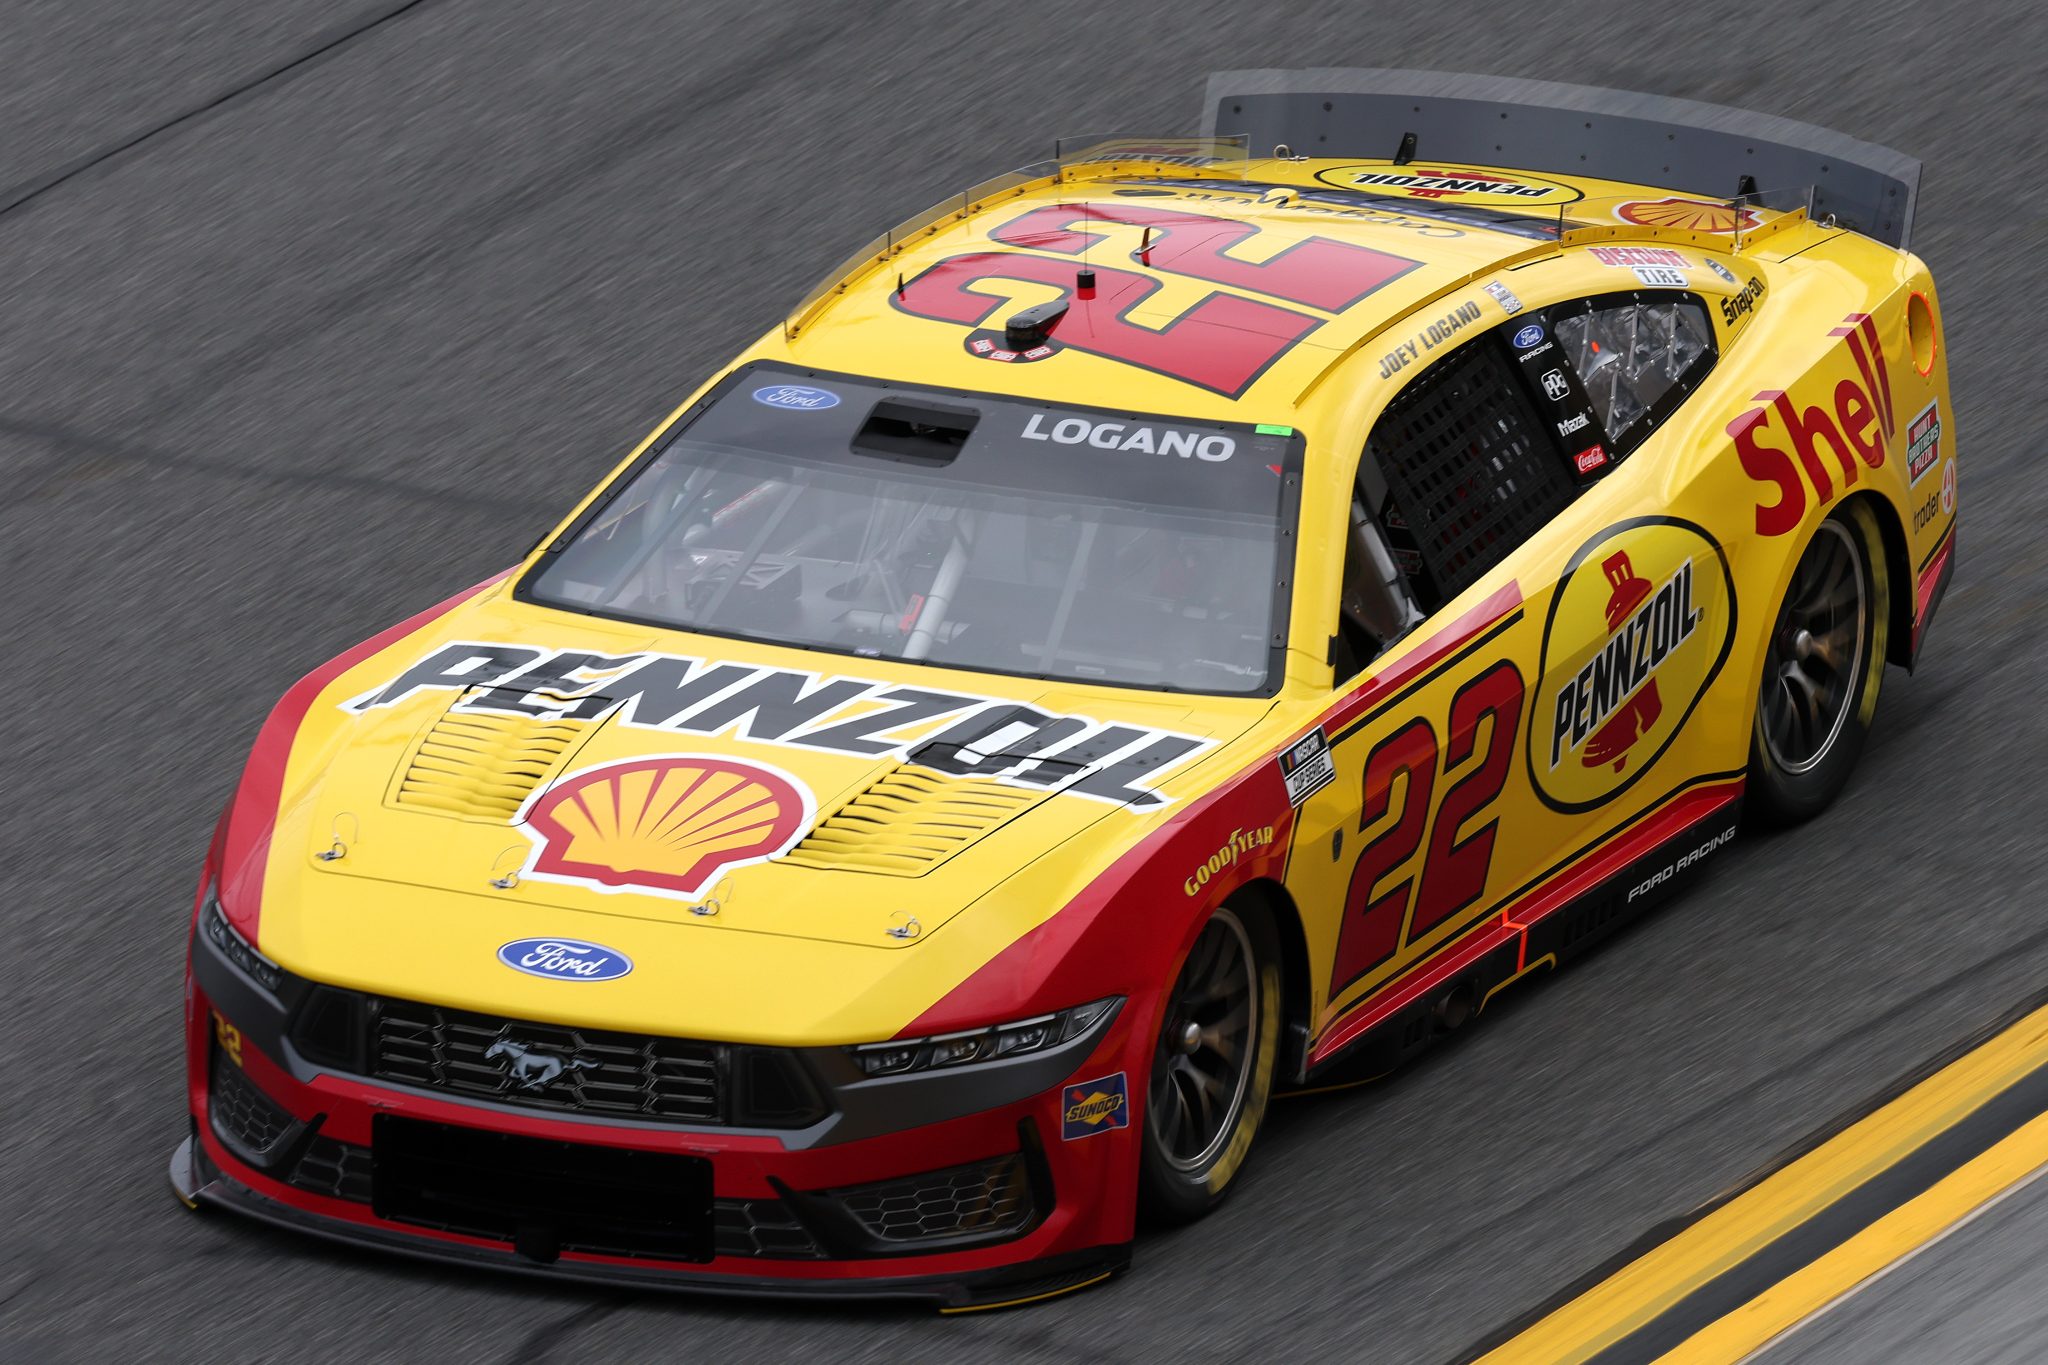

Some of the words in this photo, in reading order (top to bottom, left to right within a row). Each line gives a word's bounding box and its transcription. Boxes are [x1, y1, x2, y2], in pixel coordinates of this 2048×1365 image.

[1354, 173, 1555, 197] PENNZOIL
[1587, 247, 1693, 268] DISCOUNT
[1637, 269, 1684, 284] TIRE
[889, 203, 1427, 401] 22
[1378, 339, 1419, 380] JOEY
[1418, 300, 1482, 351] LOGANO
[1518, 327, 1542, 347] Ford
[1545, 372, 1567, 397] PPG
[1021, 414, 1237, 462] LOGANO
[1557, 411, 1590, 437] Mazak
[1725, 313, 1895, 537] Shell
[1914, 448, 1933, 475] PIZZA
[1550, 556, 1700, 772] PENNZOIL
[344, 641, 1218, 808] PENNZOIL
[1327, 658, 1526, 1008] 22
[1184, 826, 1273, 897] GOODYEAR
[1627, 864, 1674, 904] FORD
[1676, 825, 1737, 873] RACING
[1069, 1096, 1120, 1120] SUNOCO
